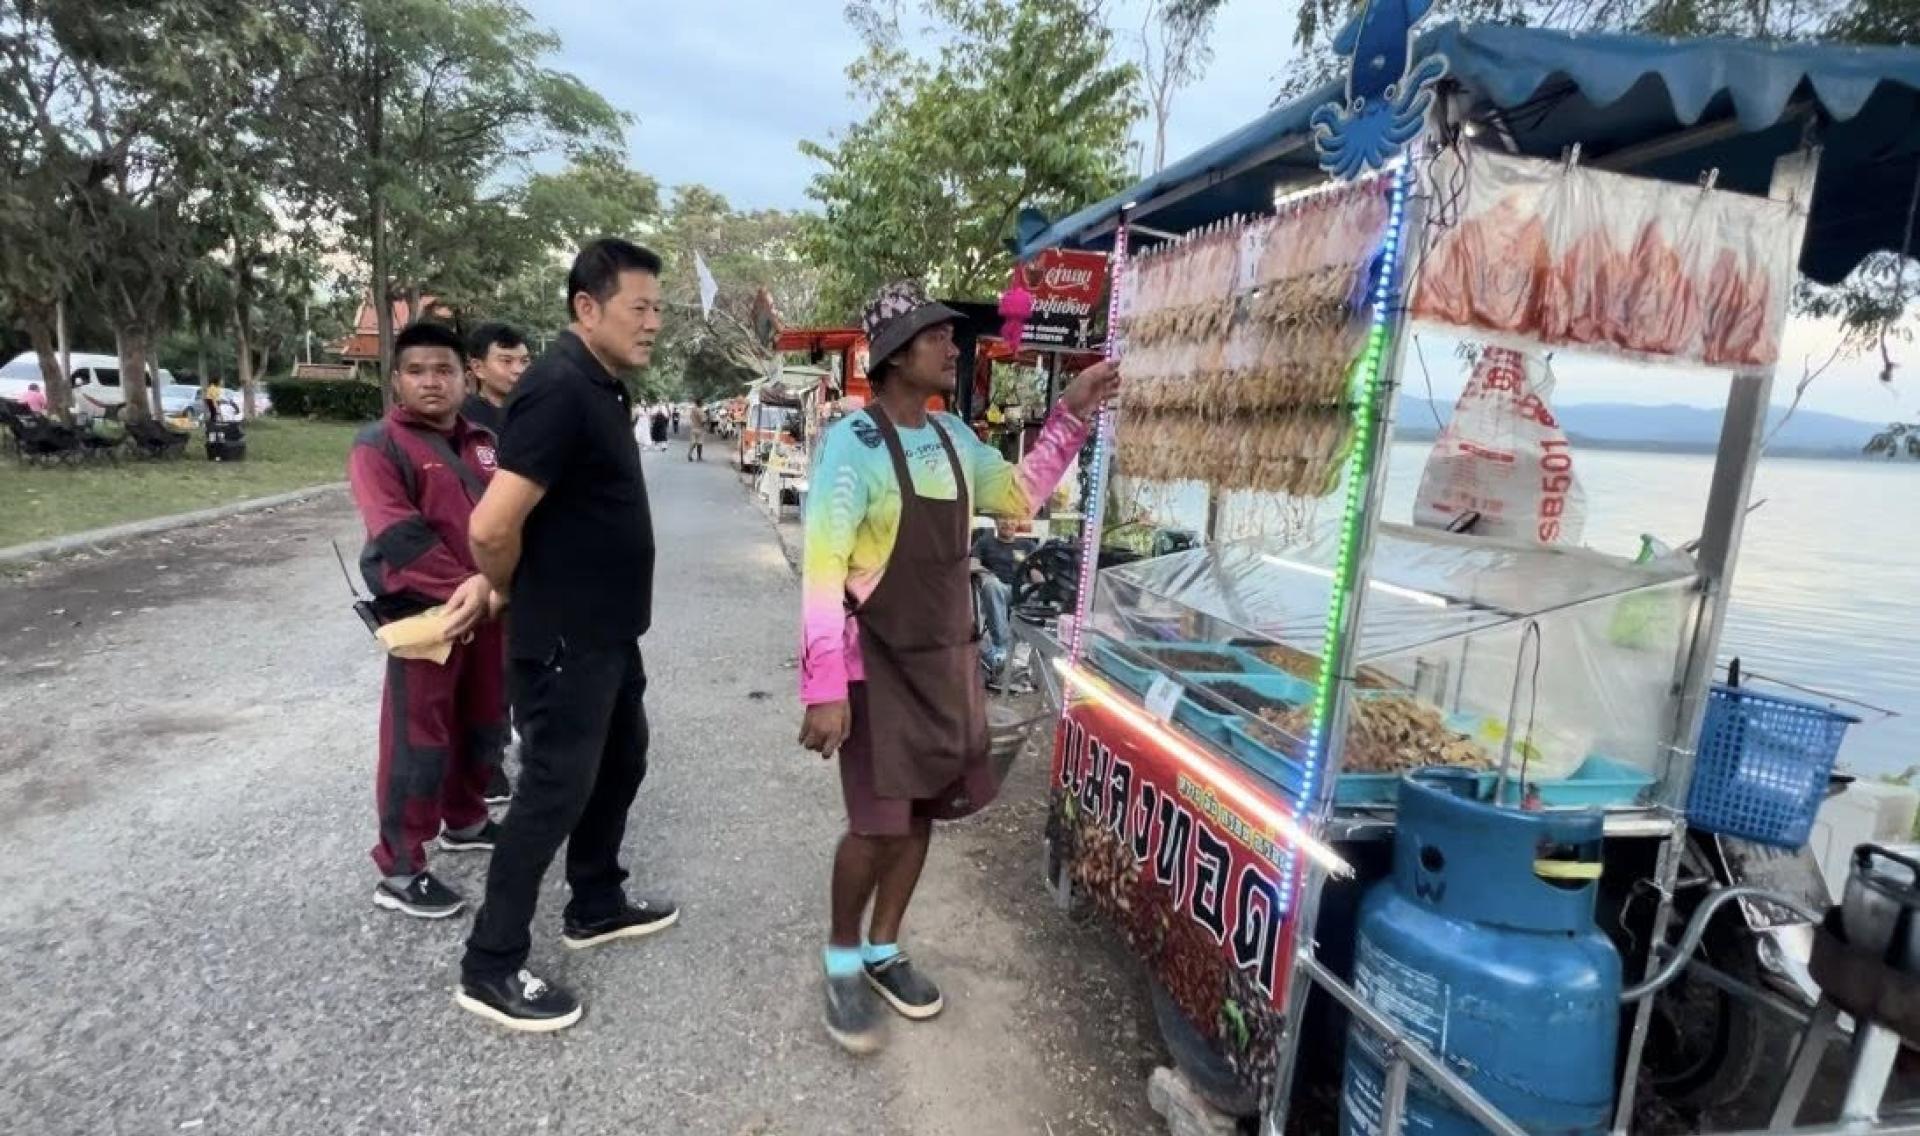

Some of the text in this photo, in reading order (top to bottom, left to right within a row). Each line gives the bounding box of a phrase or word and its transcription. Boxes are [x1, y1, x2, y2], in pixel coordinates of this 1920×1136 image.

[1538, 440, 1572, 541] SB501
[1061, 716, 1280, 1001] แมลงทอด
